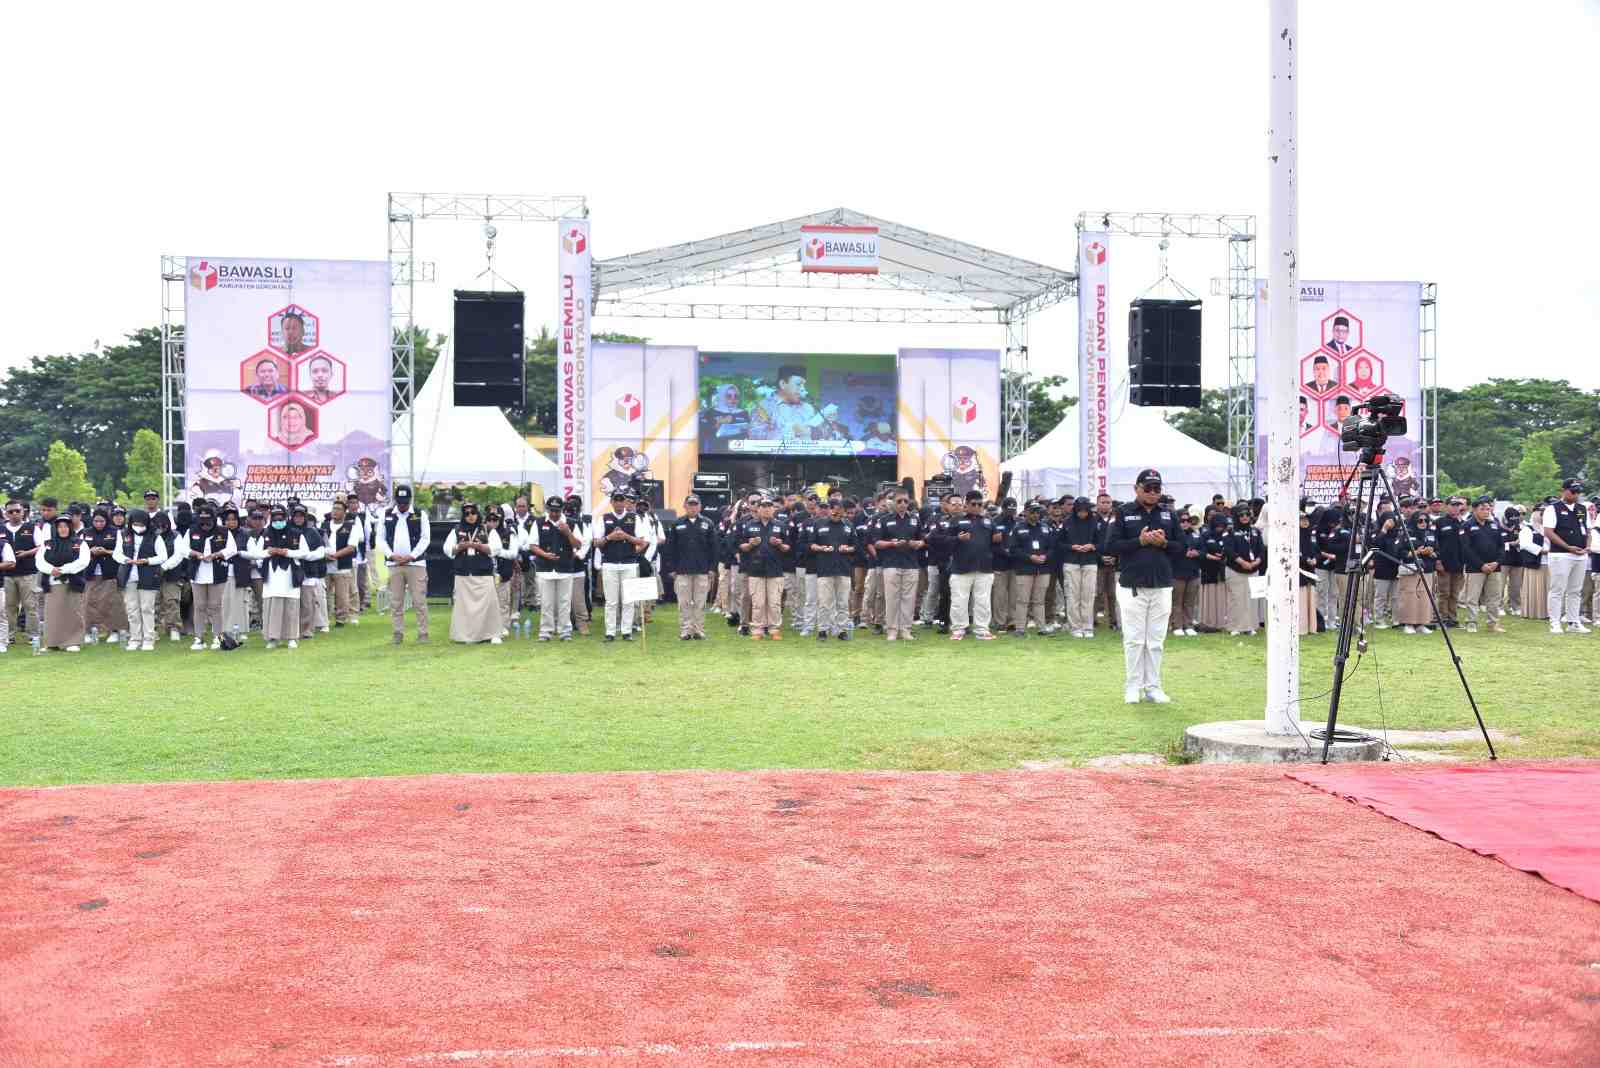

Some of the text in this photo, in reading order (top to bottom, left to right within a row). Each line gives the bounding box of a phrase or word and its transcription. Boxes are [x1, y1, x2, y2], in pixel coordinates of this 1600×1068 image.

[218, 266, 293, 278] BAWASLU
[825, 241, 876, 254] BAWASLU
[563, 274, 574, 354] PEMILU
[1096, 284, 1106, 352] BADAN
[1300, 287, 1324, 296] ASLU
[563, 361, 574, 480] PENGAWAS
[576, 300, 585, 495] UPATEN GORONTALO
[1086, 319, 1096, 498] PROVINSI GORONTAL
[1096, 358, 1106, 469] PENGAWAS
[244, 482, 338, 492] BERSAMA BAWASLU
[244, 491, 337, 500] TEGAKKAN KEADILA
